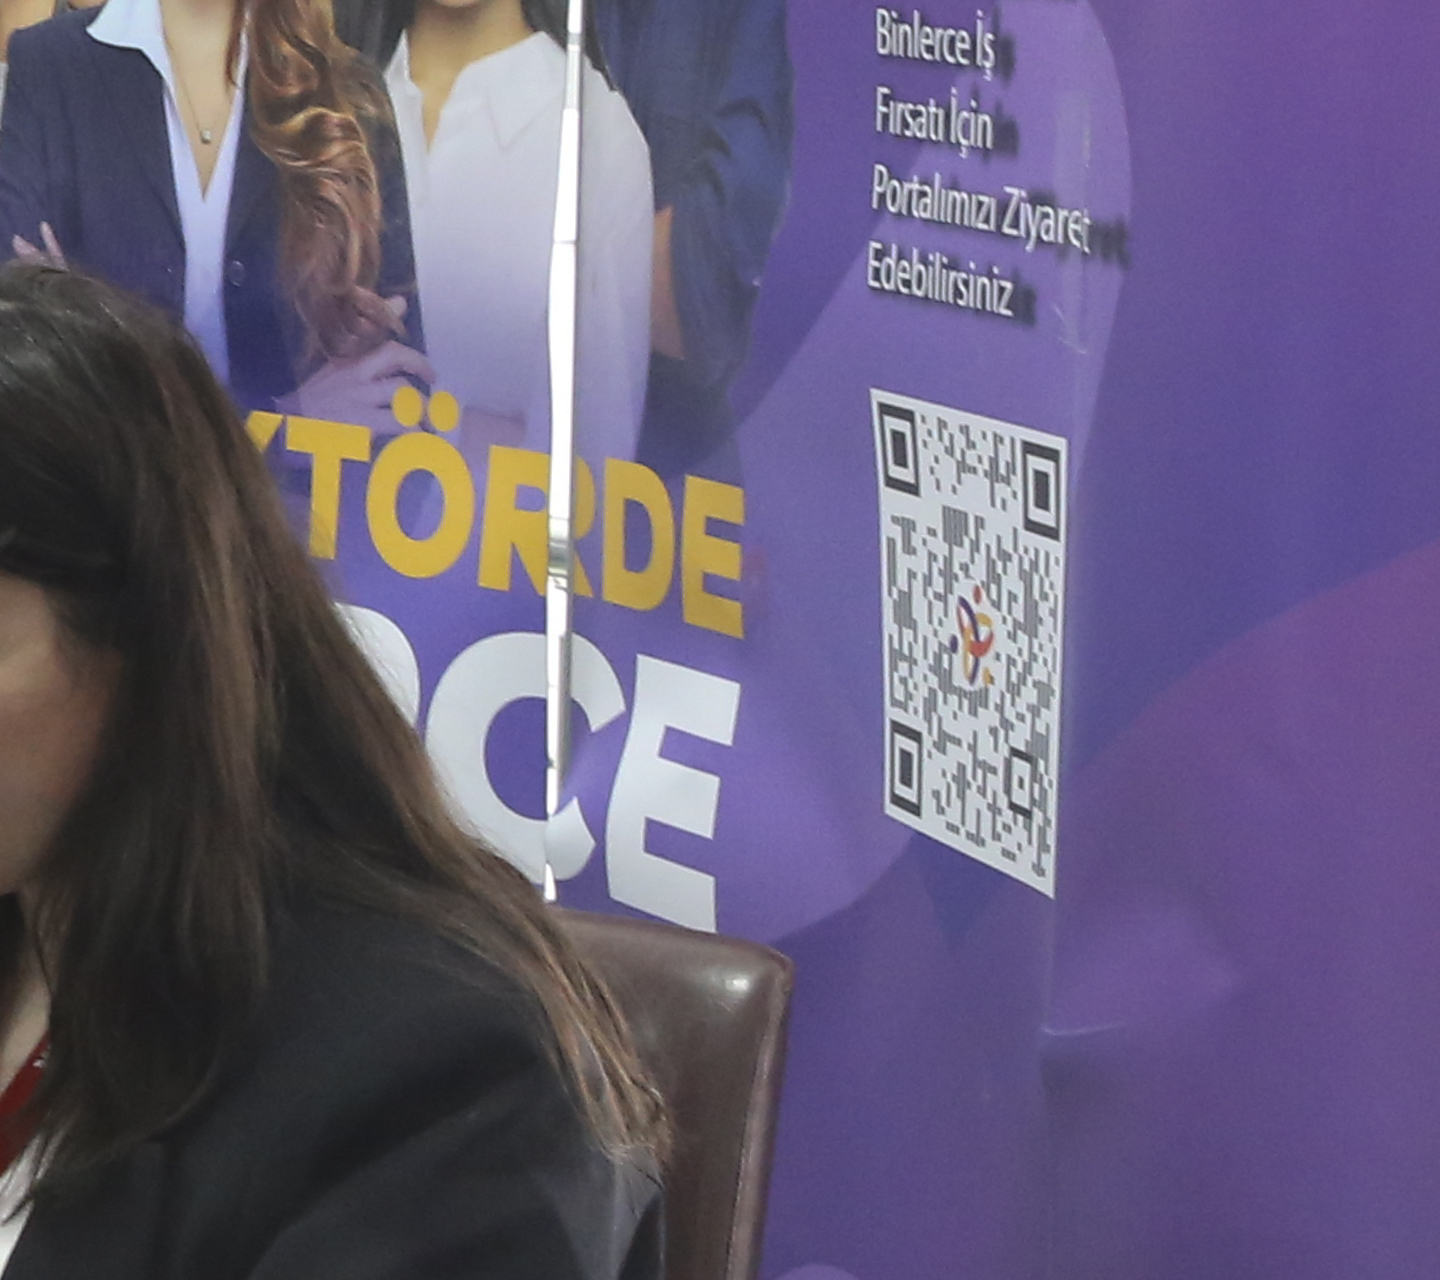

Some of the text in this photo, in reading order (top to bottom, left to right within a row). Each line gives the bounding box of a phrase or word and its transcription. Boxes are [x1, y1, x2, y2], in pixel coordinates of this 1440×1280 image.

[875, 7, 997, 81] Binlerce İş
[875, 86, 994, 160] Fırsatı İçin
[871, 164, 1092, 255] Portalımızı Ziyaret
[866, 240, 1015, 318] Edebilirsiniz
[247, 386, 745, 640] TÖRDE
